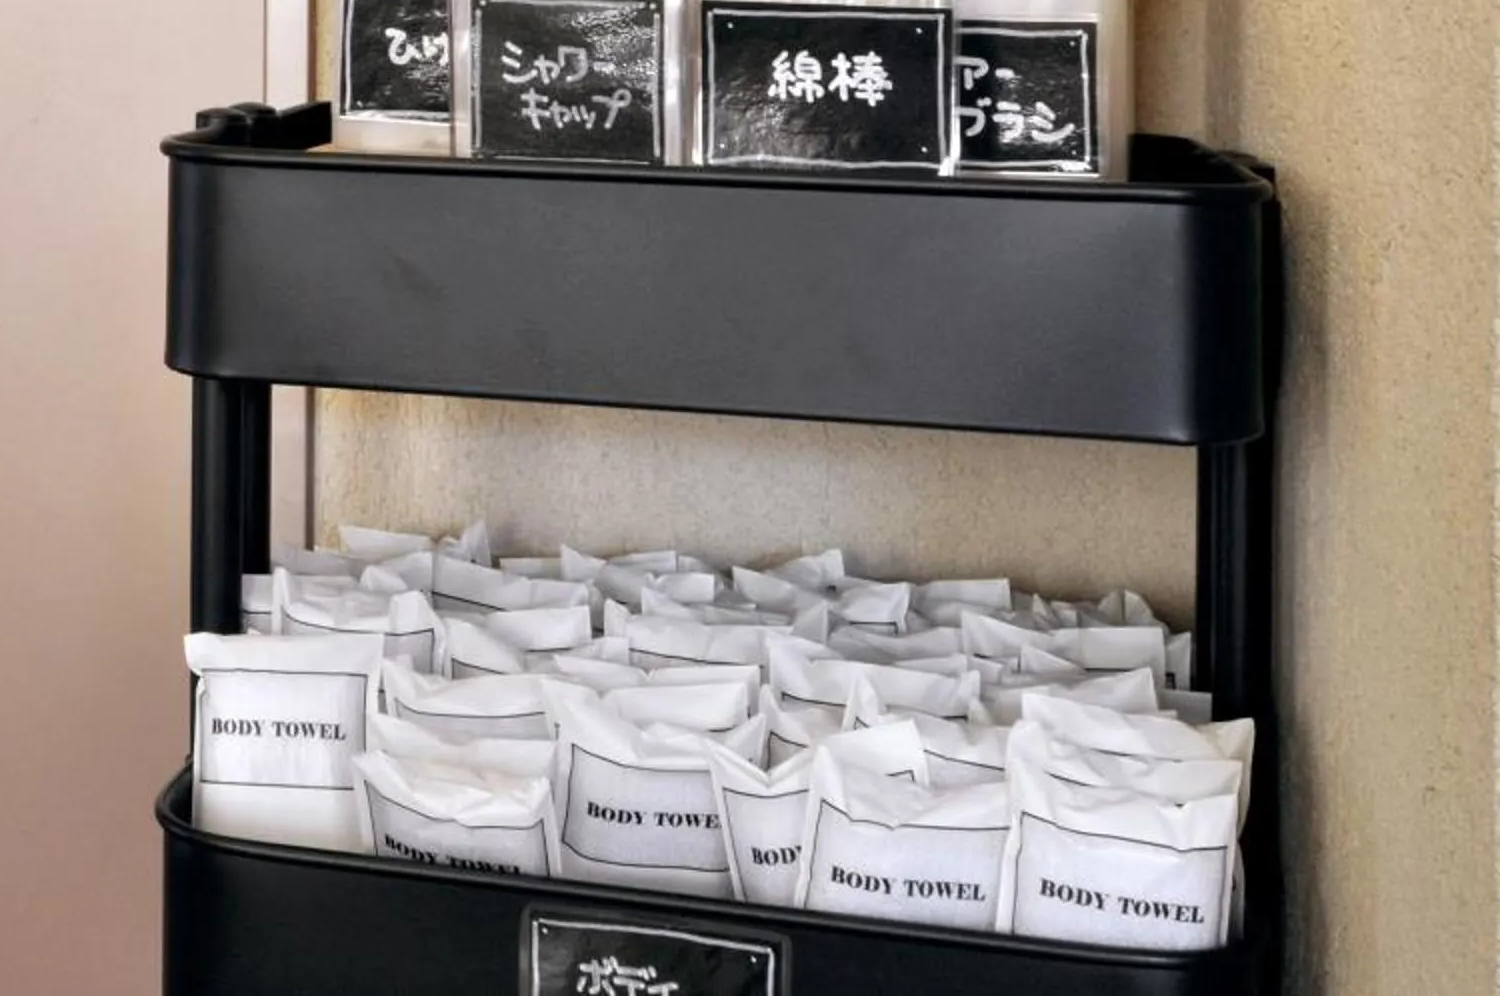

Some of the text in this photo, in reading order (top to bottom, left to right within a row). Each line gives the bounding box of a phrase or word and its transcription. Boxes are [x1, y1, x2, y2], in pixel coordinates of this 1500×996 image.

[501, 40, 617, 84] シャワー
[767, 49, 893, 107] 綿棒
[955, 55, 1018, 90] アー
[520, 87, 632, 130] キャップ
[955, 96, 1076, 143] ブラシ
[211, 716, 347, 742] BODY TOWEL
[587, 801, 722, 830] BODY TOWE
[384, 833, 439, 865] BODY
[830, 865, 986, 902] BODY TOWEL
[1039, 877, 1206, 925] BODY TOWEL
